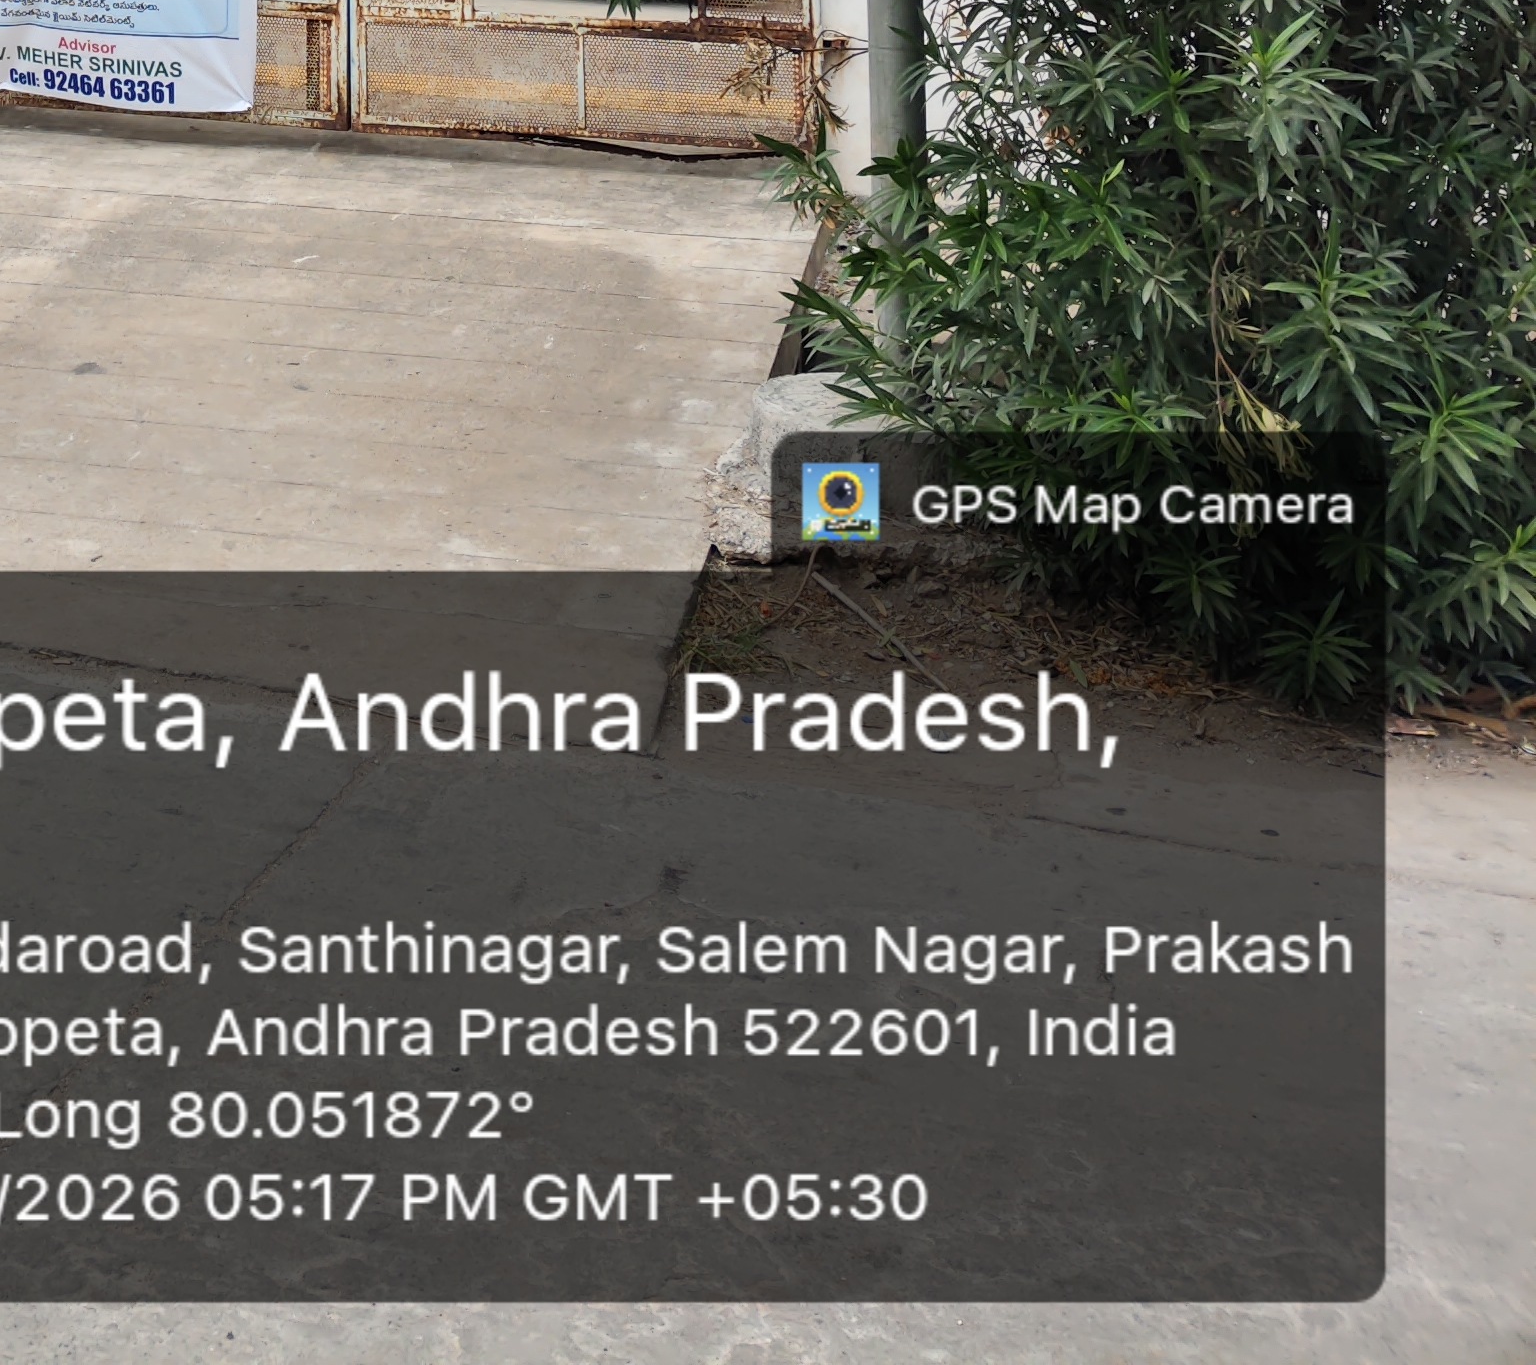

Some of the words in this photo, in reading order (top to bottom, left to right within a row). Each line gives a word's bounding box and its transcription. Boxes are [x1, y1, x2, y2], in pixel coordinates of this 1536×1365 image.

[16, 45, 84, 71] MEHER
[88, 56, 183, 78] SRINIVAS
[57, 36, 117, 55] Advisor
[9, 68, 40, 88] Cell:
[43, 69, 106, 98] 92464
[109, 77, 175, 104] 63361
